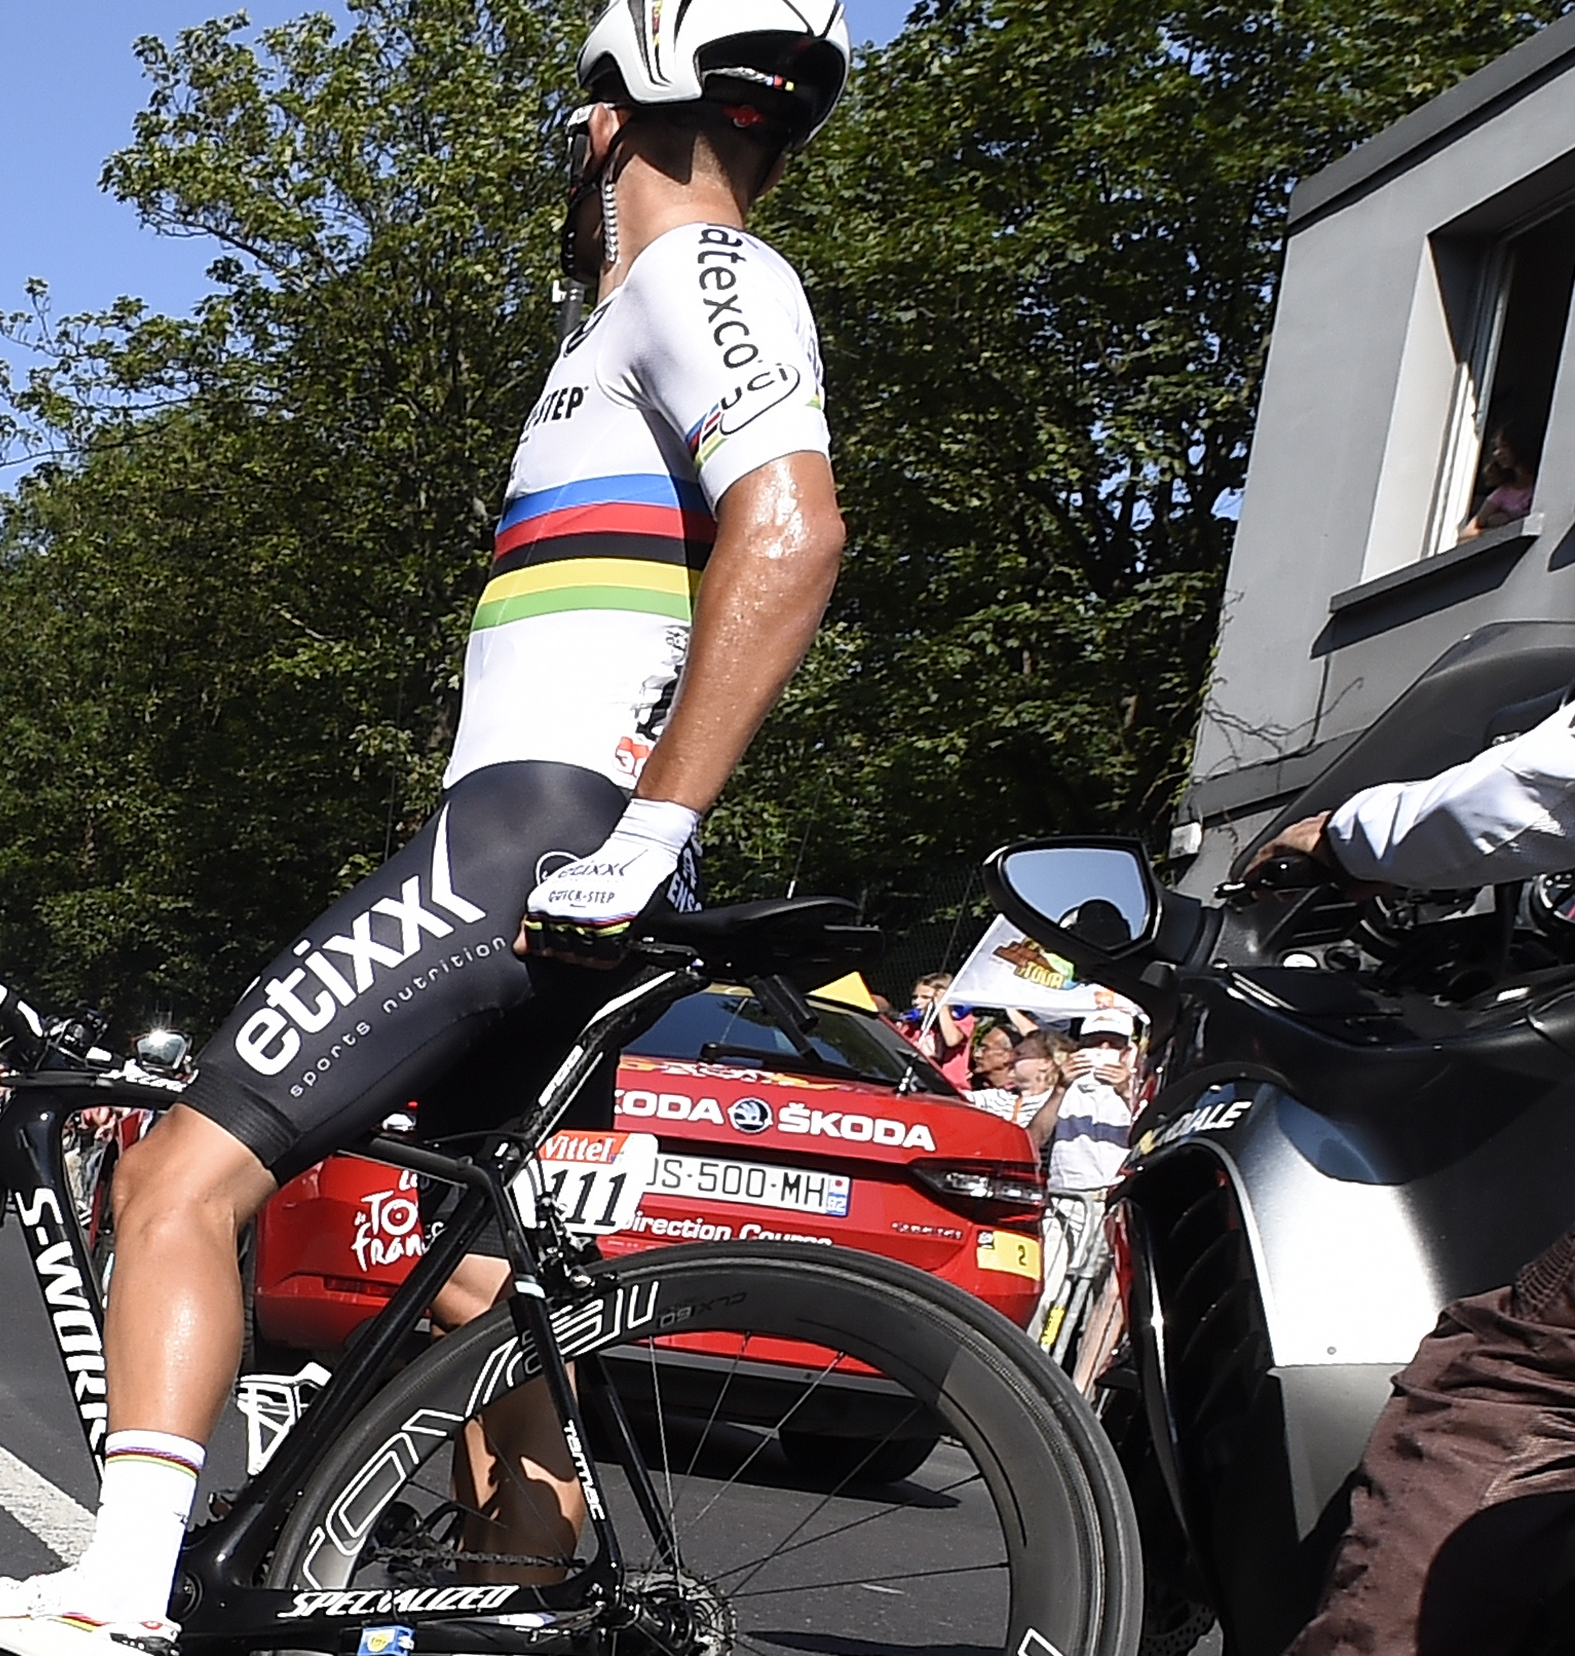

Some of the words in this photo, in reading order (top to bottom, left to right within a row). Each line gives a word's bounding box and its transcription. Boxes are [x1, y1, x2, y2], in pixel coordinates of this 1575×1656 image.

[697, 228, 758, 369] atexco
[235, 875, 454, 1075] etixx
[290, 1020, 373, 1098] sports
[382, 936, 507, 1014] nutrition
[544, 1135, 617, 1162] Vittel
[777, 1102, 936, 1151] ŠKODA
[276, 1584, 520, 1619] SPECIALIZED
